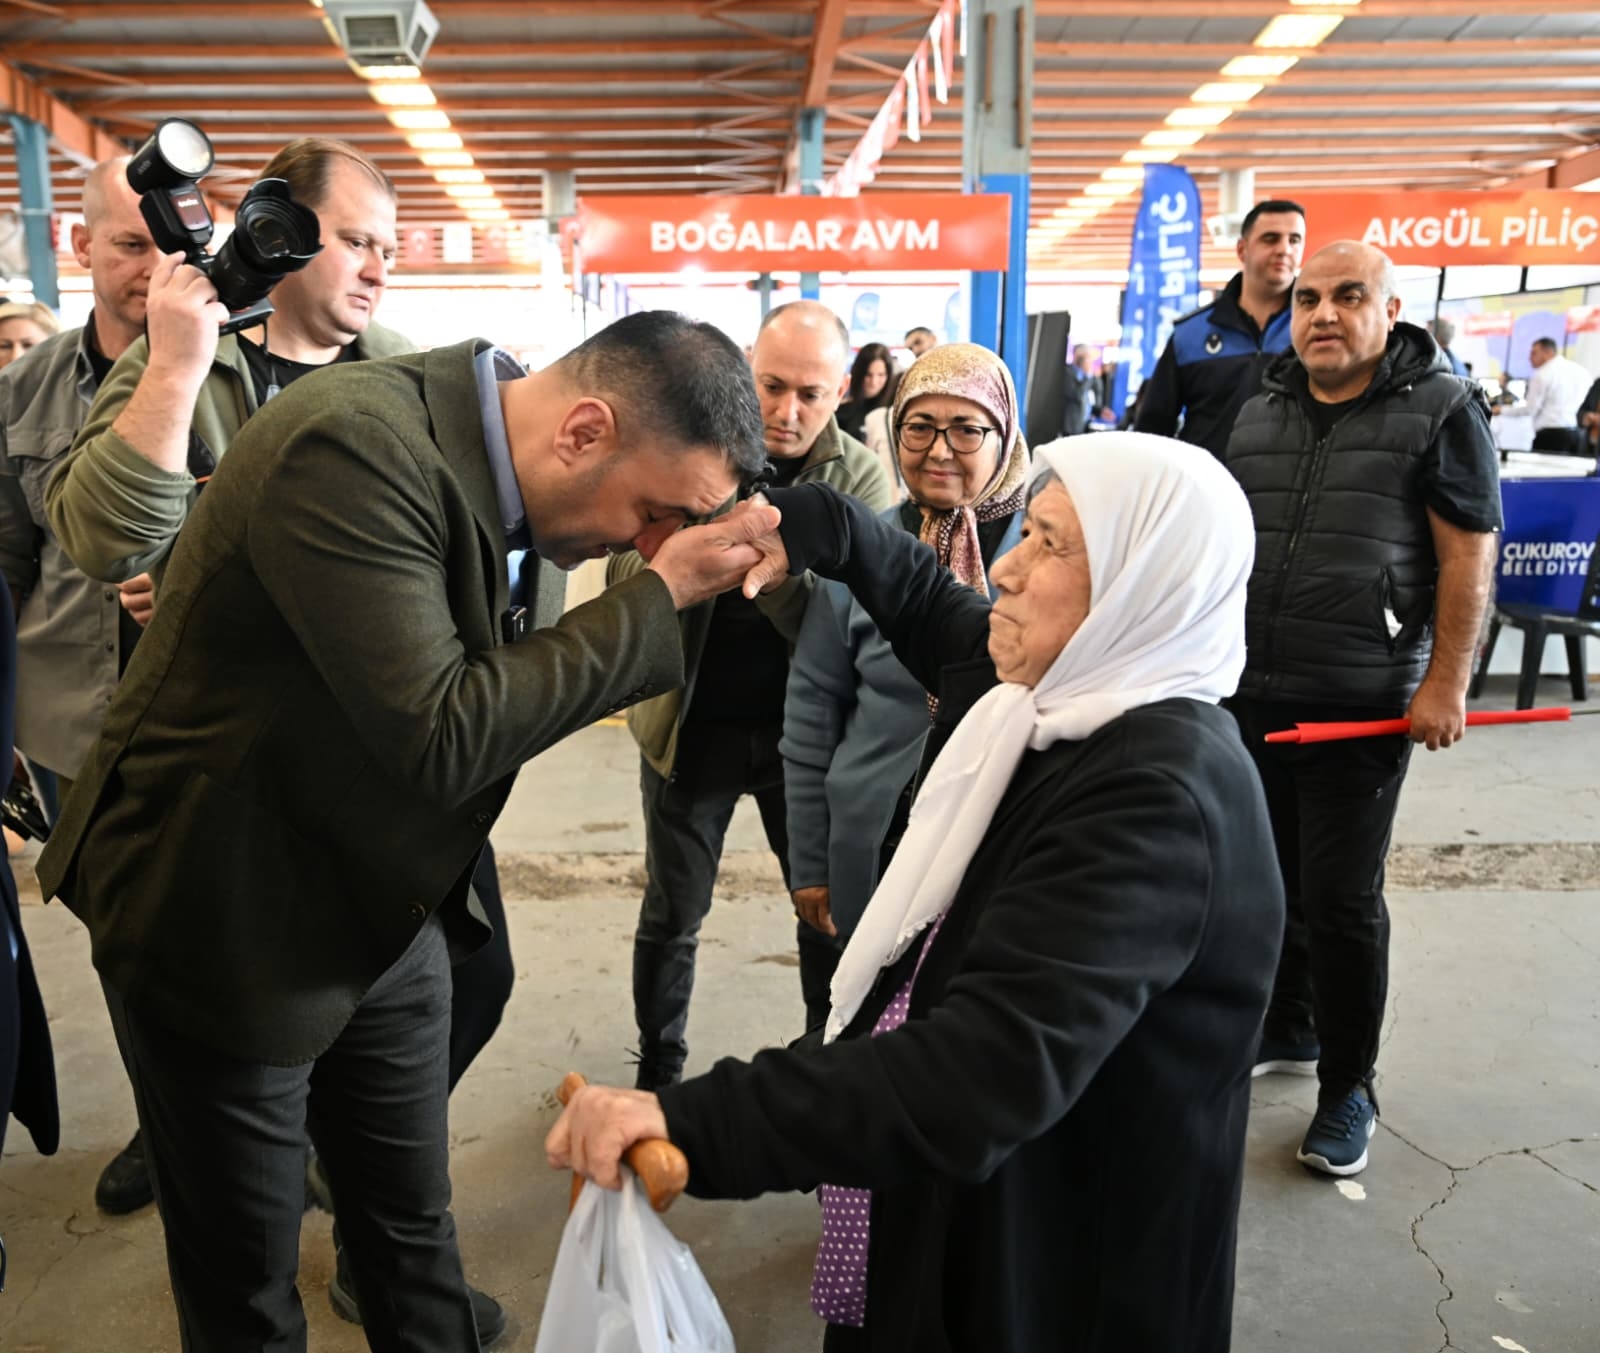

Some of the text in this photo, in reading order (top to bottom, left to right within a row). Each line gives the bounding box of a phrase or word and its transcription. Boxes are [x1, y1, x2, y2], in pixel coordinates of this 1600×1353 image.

[650, 213, 940, 252] BOĞALAR AVM
[1361, 207, 1599, 252] AKGÜL PİLİÇ
[1503, 542, 1597, 562] ÇUKUROV
[1501, 559, 1589, 576] BELEDİYE
